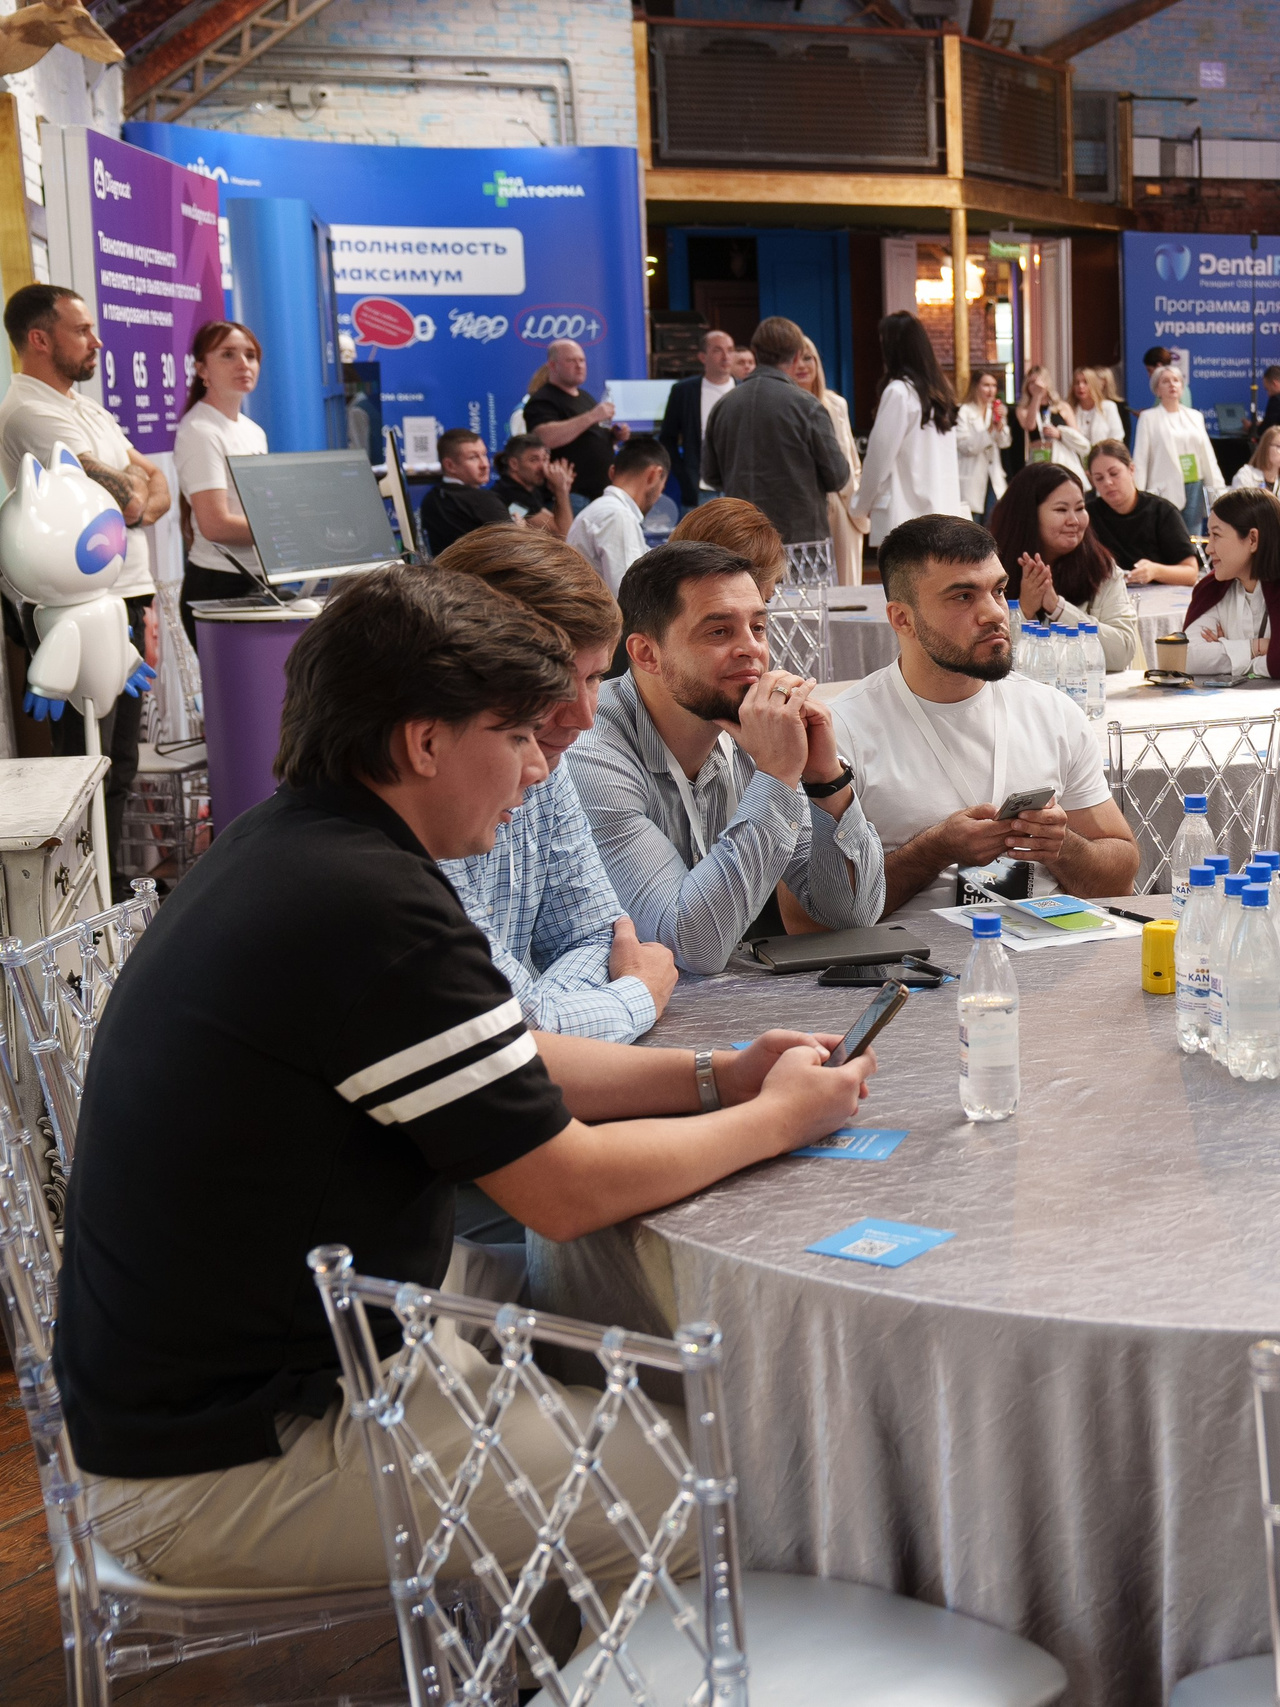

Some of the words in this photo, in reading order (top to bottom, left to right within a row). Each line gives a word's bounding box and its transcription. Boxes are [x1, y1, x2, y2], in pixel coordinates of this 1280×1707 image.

[333, 268, 463, 286] максимум
[1155, 296, 1250, 316] Программа
[105, 350, 116, 389] 9
[132, 351, 148, 388] 65
[161, 353, 176, 388] 30
